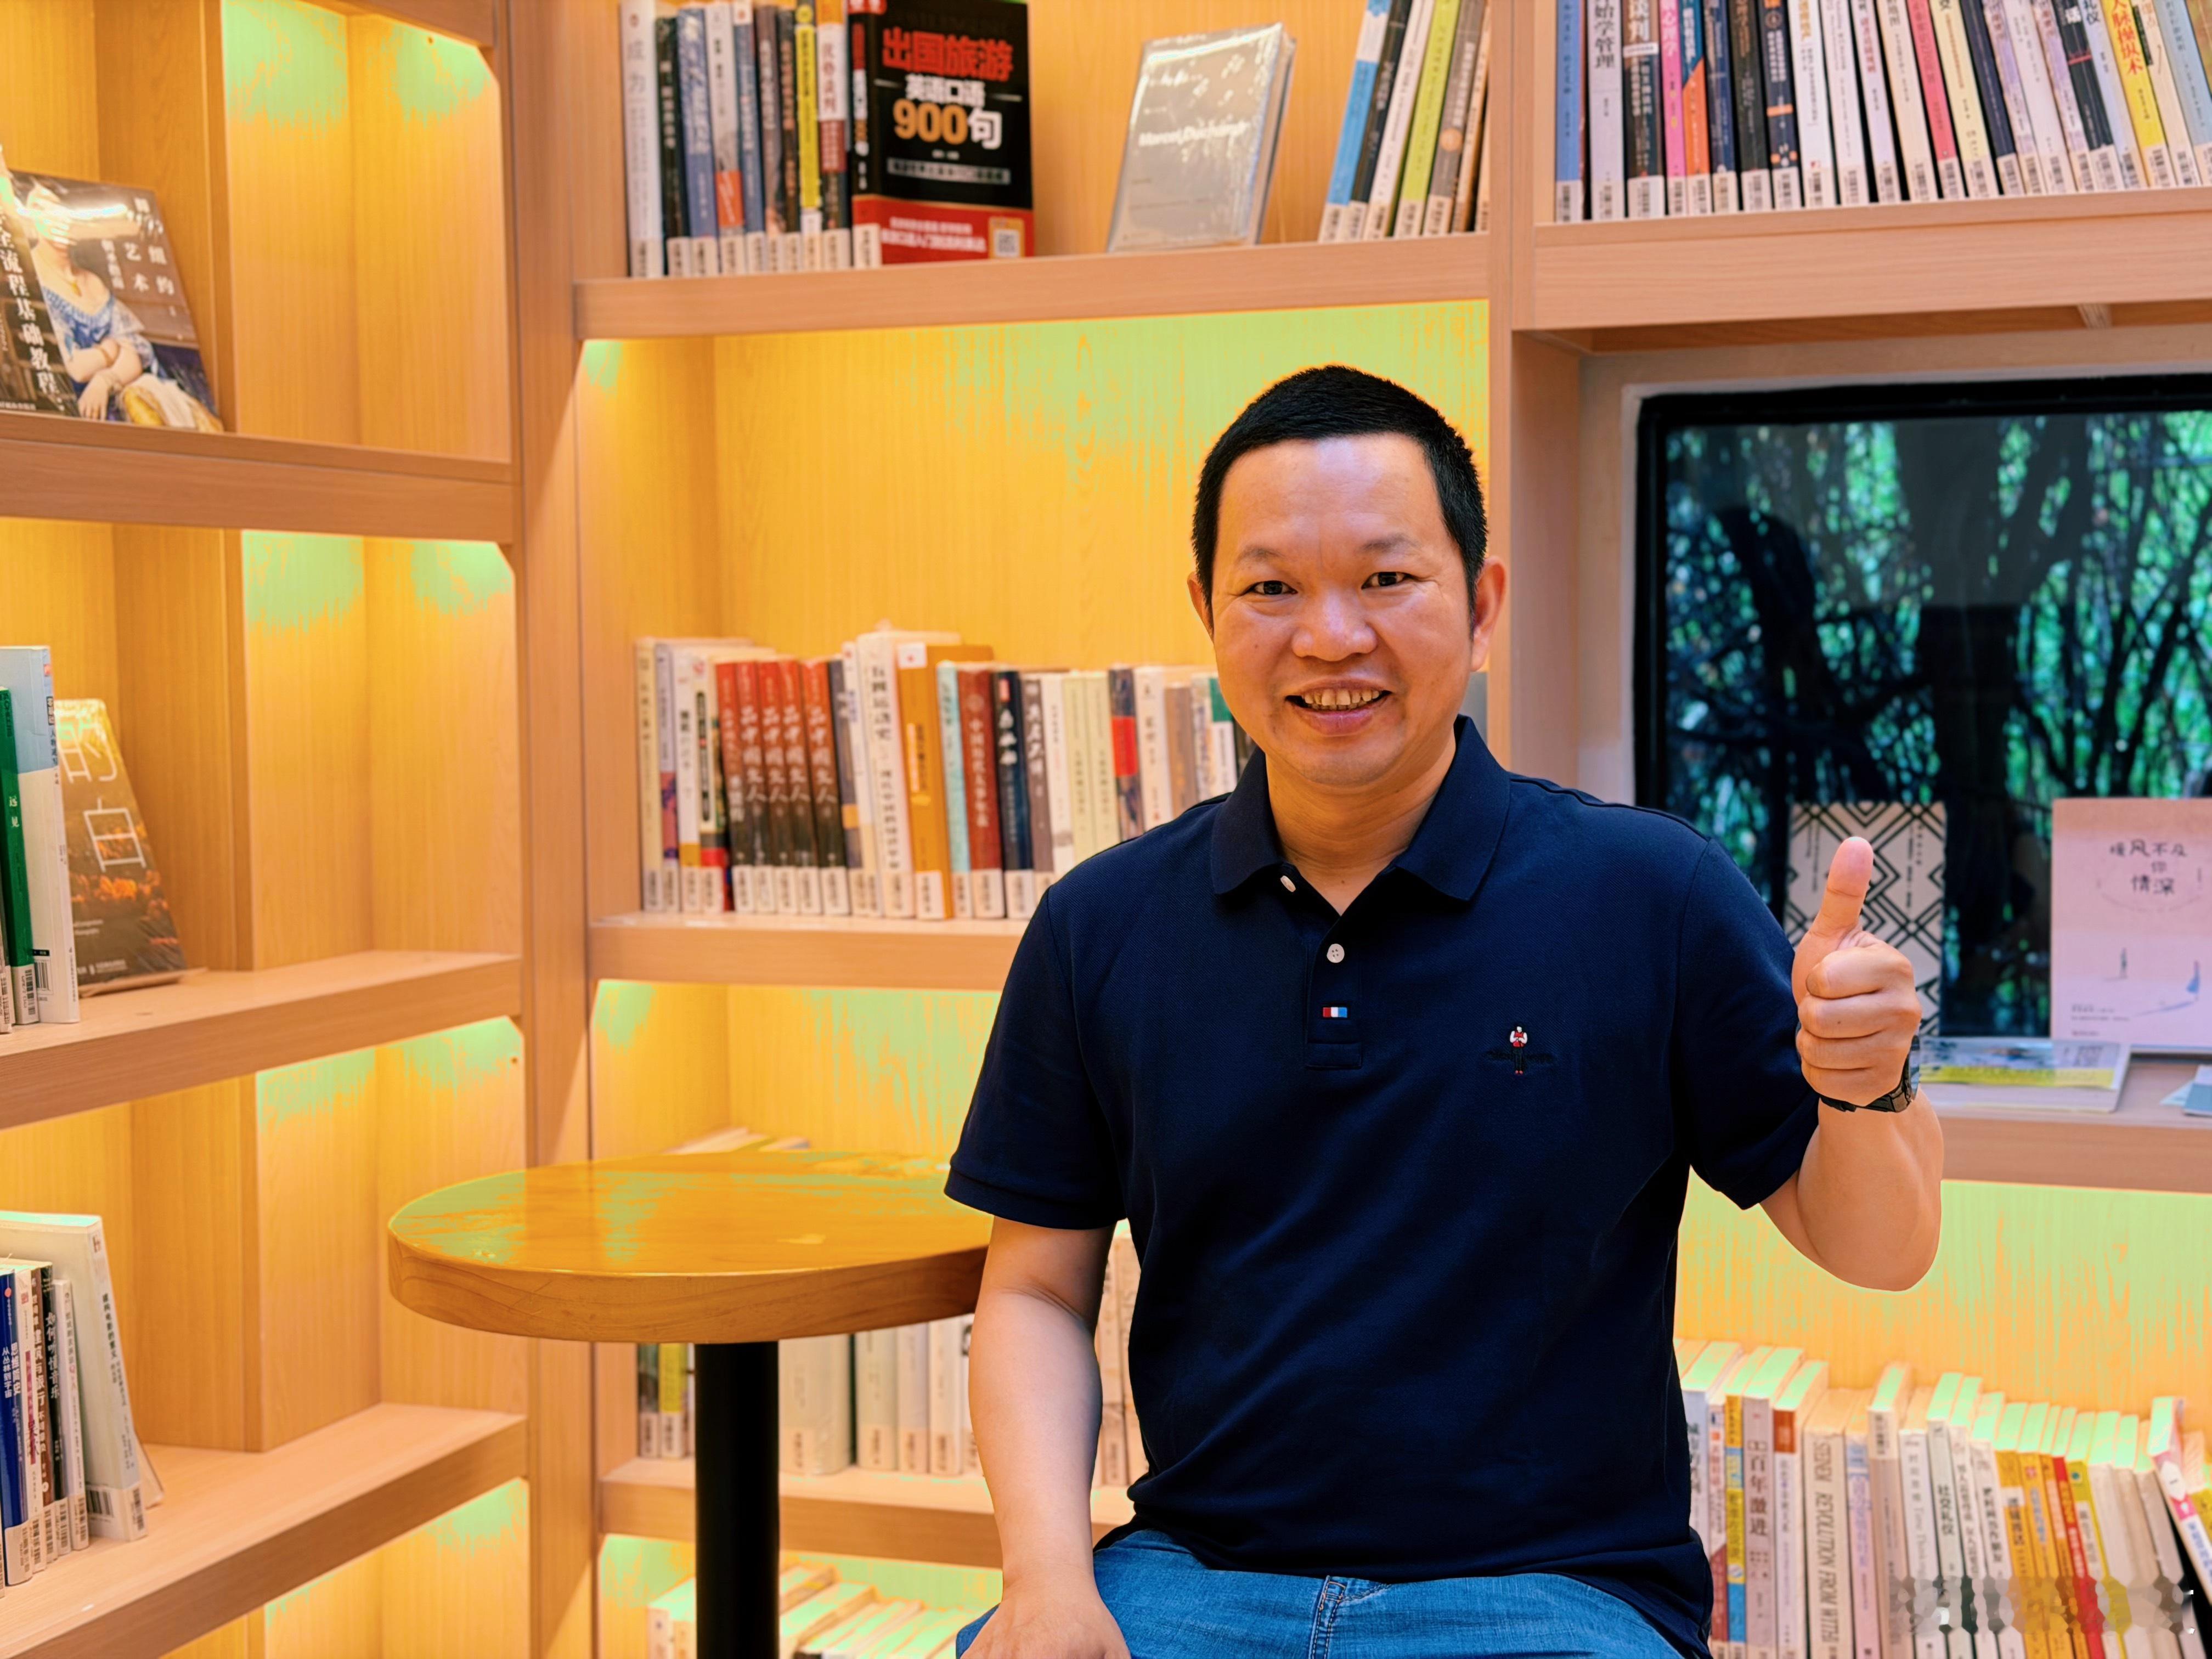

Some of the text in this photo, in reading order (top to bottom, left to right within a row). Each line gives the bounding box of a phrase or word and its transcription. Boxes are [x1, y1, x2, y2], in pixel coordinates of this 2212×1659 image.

[881, 26, 1014, 82] 出国旅游
[905, 73, 986, 108] 英语口语
[893, 98, 1002, 149] 900句
